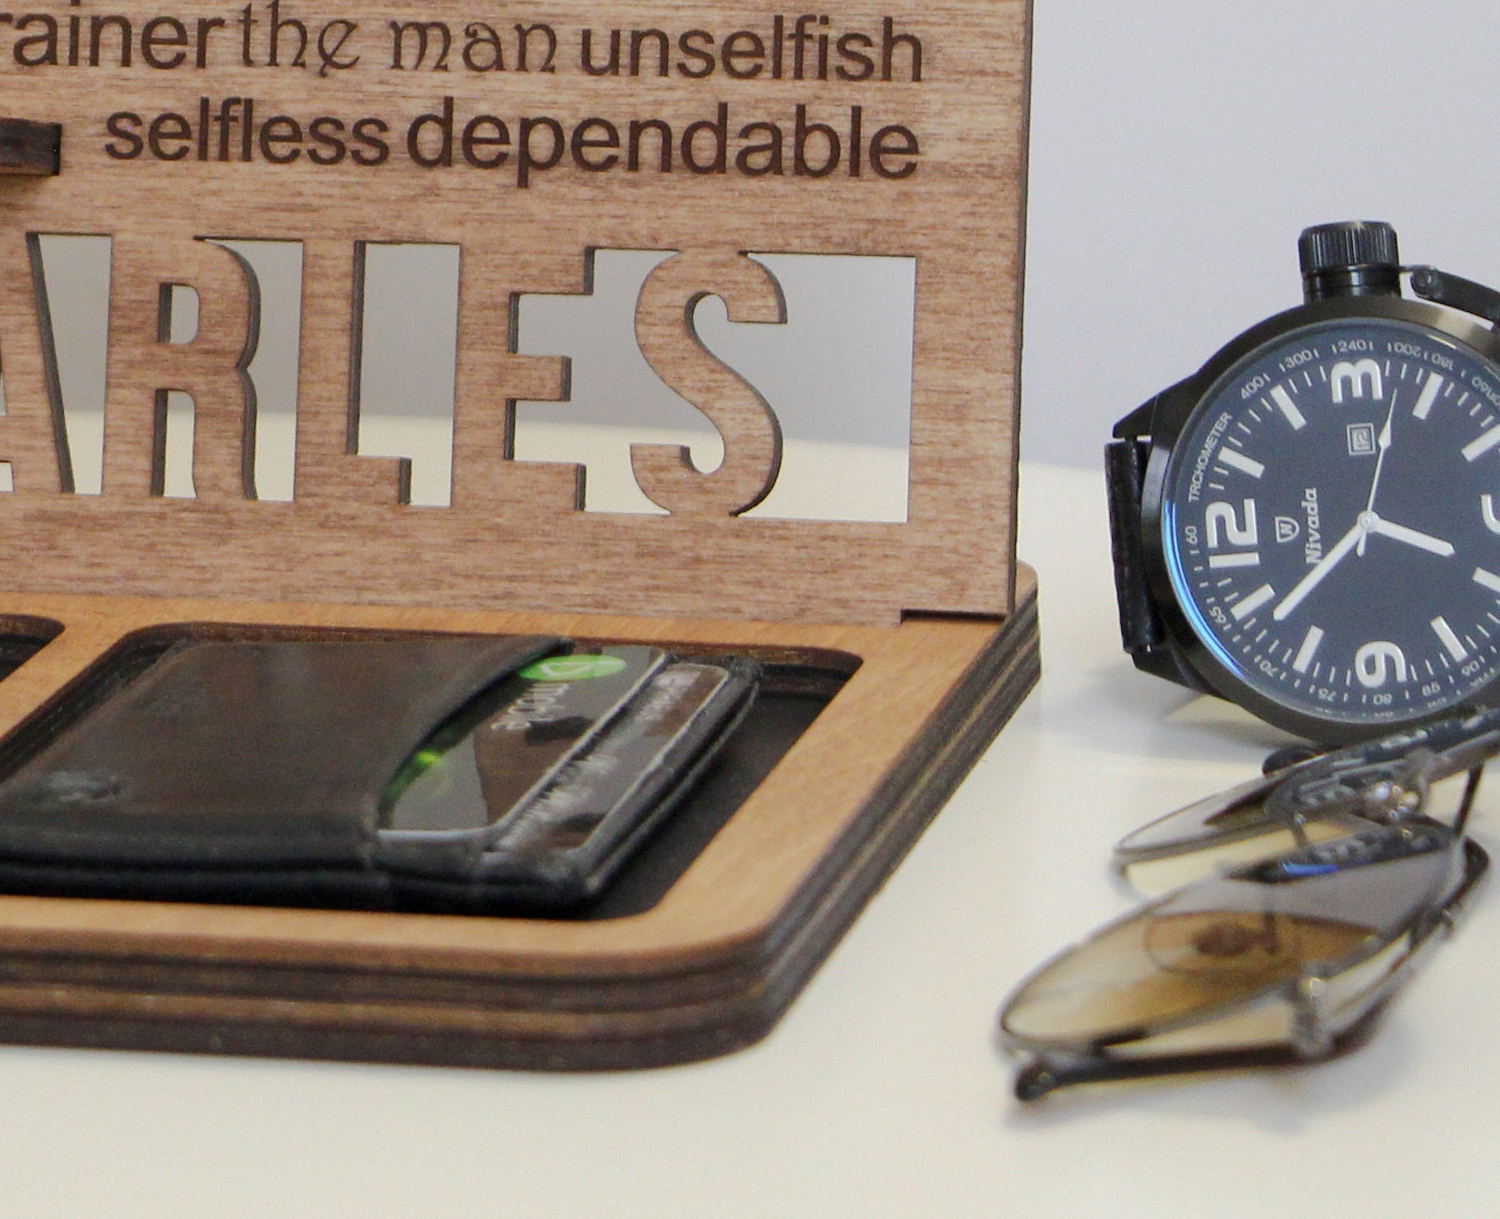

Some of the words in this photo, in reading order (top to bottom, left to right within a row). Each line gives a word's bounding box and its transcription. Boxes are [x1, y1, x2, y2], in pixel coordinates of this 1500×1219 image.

[389, 18, 556, 75] man
[581, 15, 923, 83] unselfish
[105, 97, 389, 166] selfless
[407, 97, 921, 189] dependable
[1338, 339, 1367, 353] 240
[1284, 350, 1312, 369] 300
[1240, 376, 1264, 399] 400
[1331, 358, 1383, 403] 3
[1185, 525, 1198, 545] 60
[1205, 498, 1260, 568] 12
[1301, 487, 1322, 564] Nivada
[1209, 606, 1227, 624] 65
[1260, 659, 1279, 678] 70
